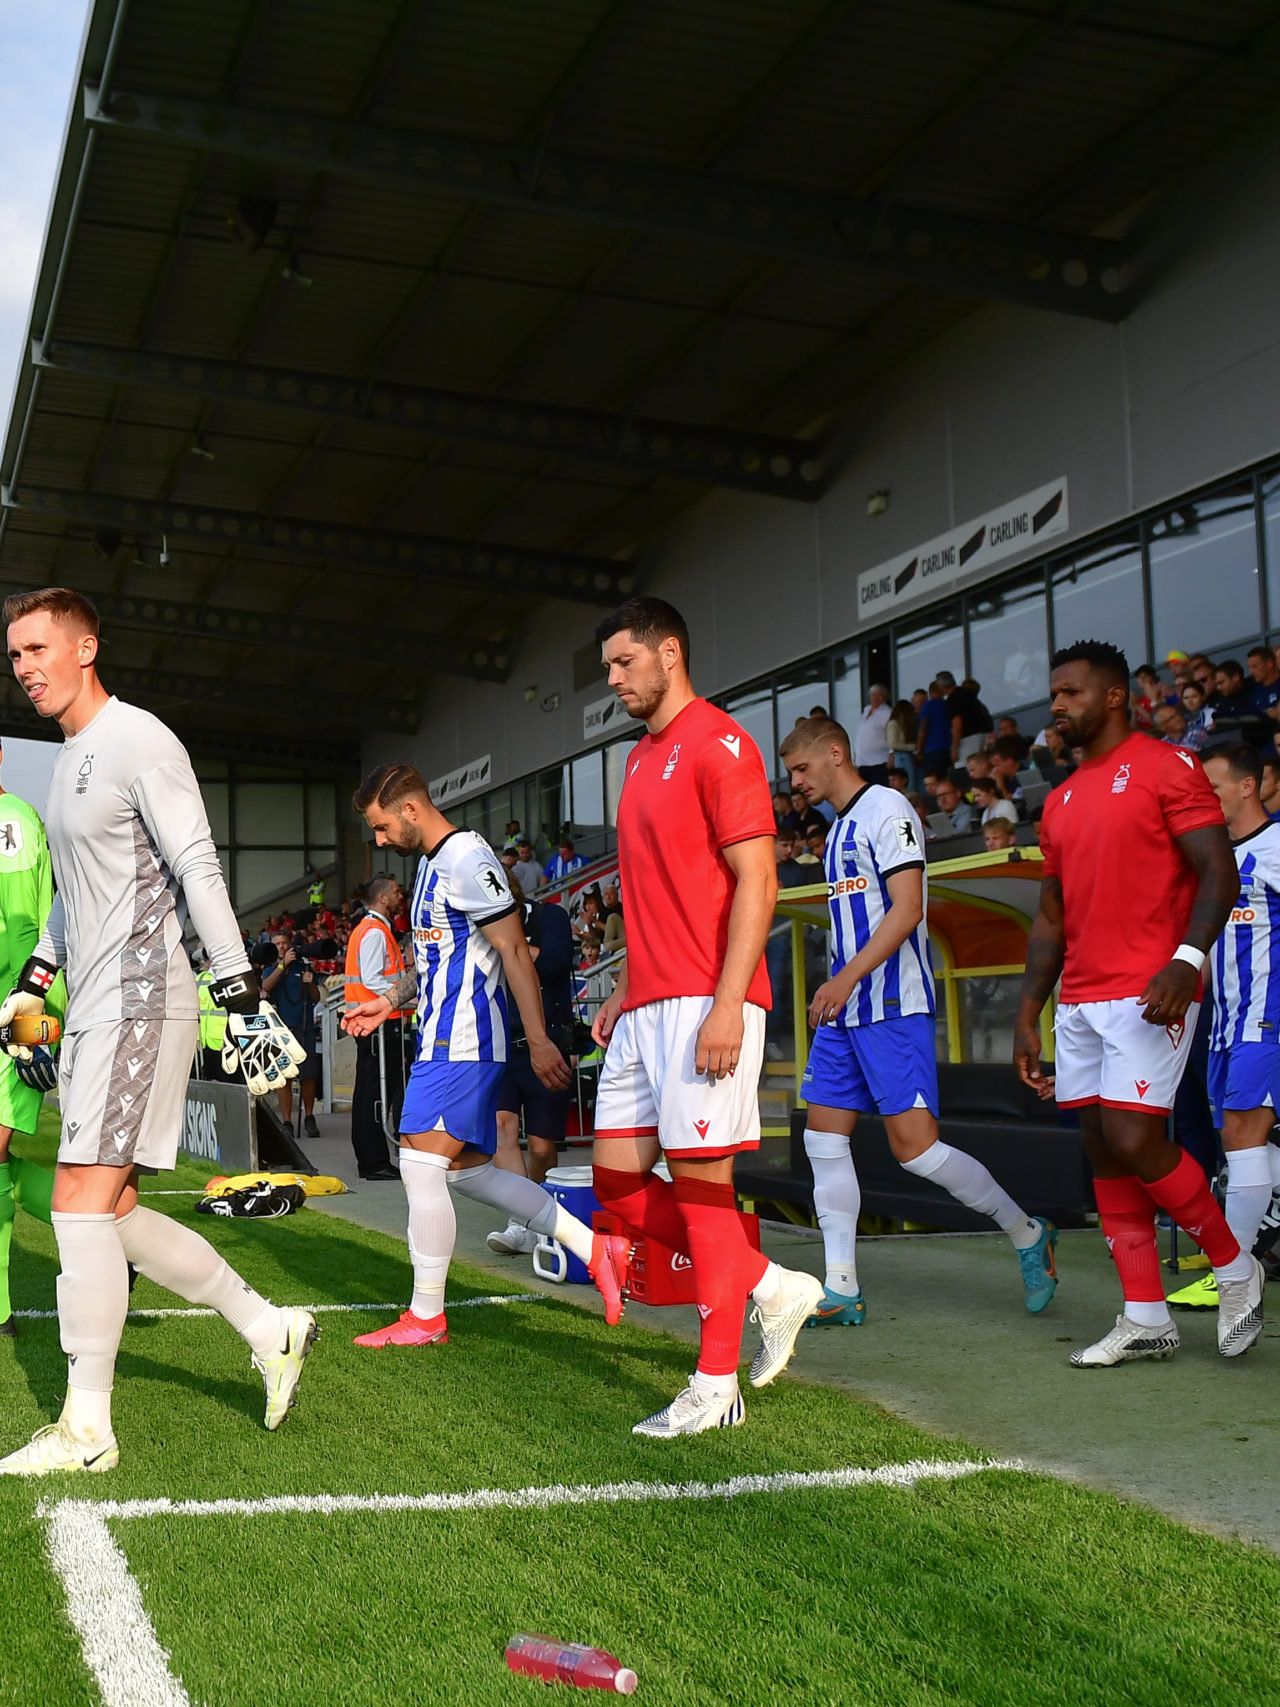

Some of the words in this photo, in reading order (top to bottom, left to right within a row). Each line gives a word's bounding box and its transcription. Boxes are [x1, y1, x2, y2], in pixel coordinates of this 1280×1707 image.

[861, 575, 892, 605] CARLING
[921, 545, 956, 577] CARLING
[989, 512, 1029, 547] CARLING
[213, 980, 248, 1002] HO
